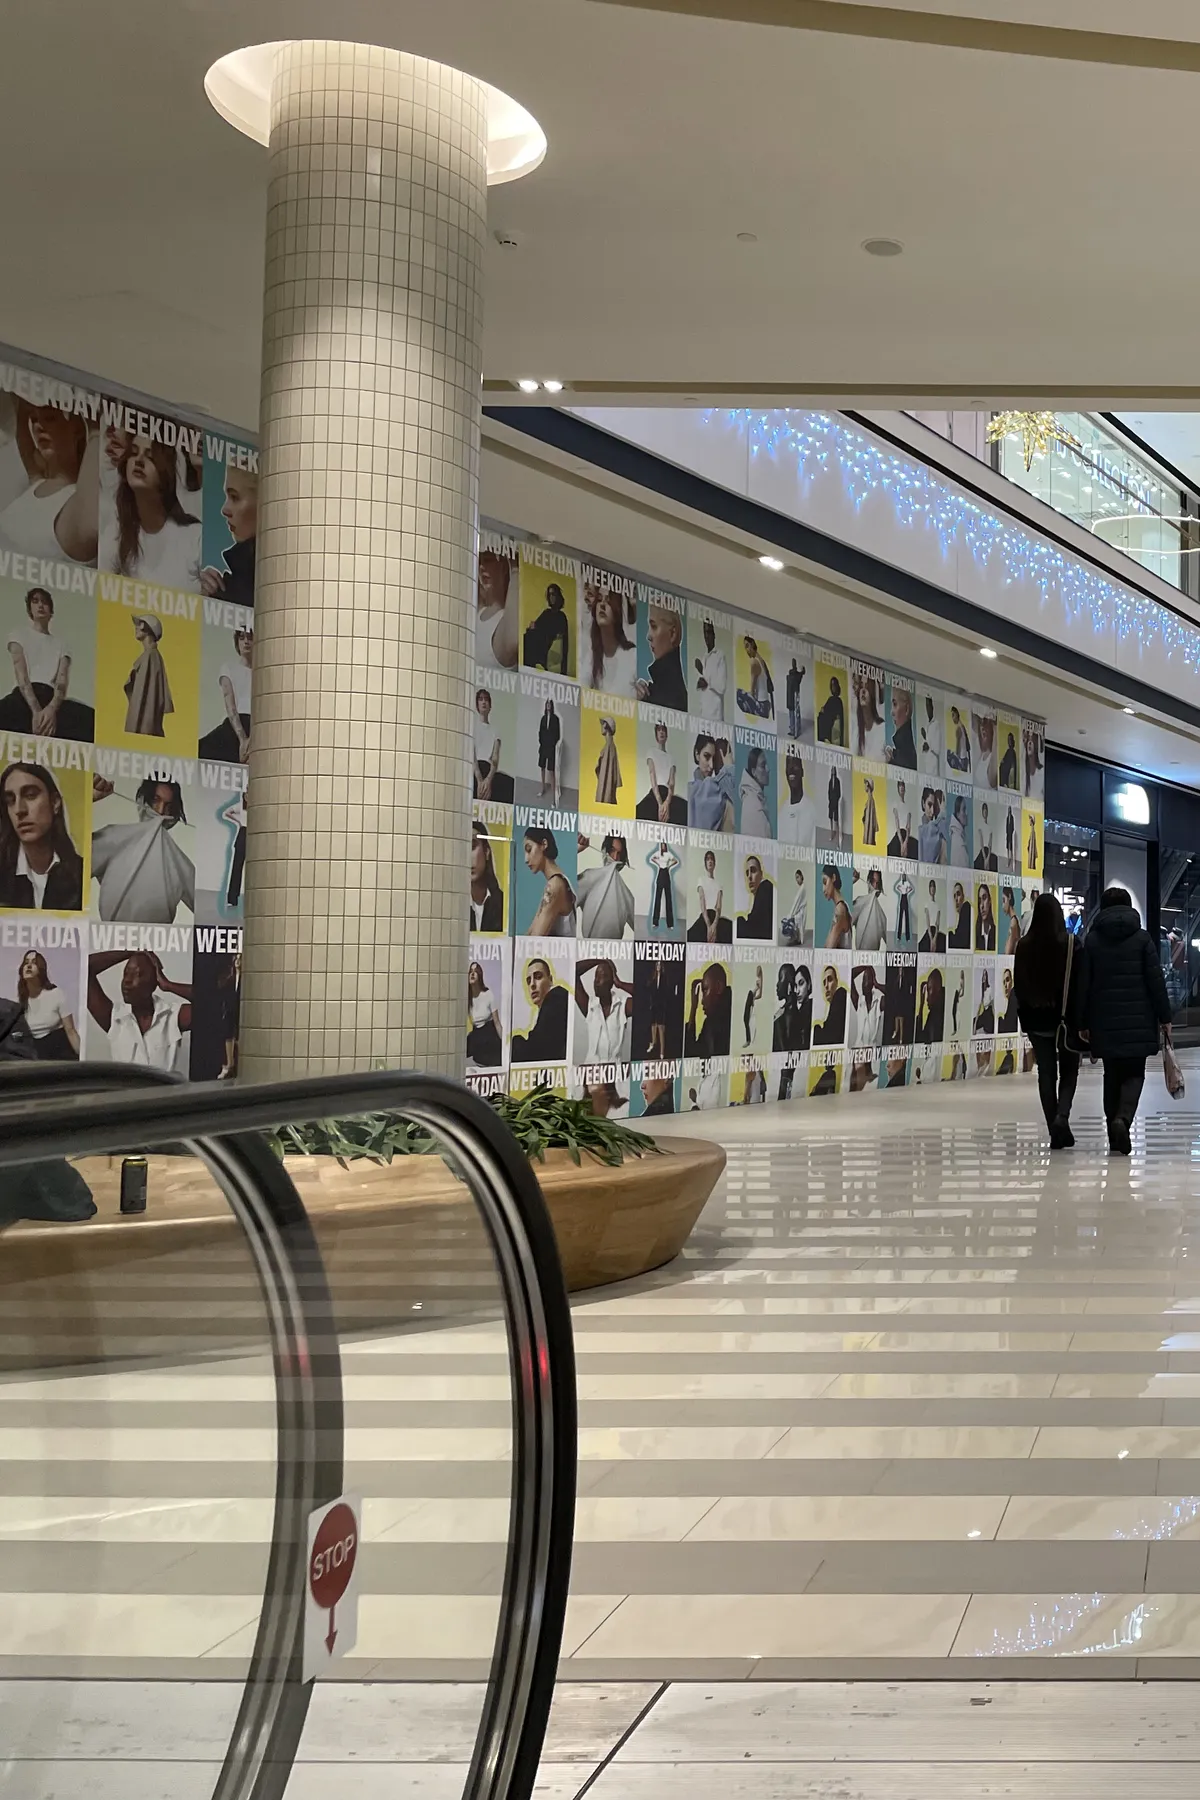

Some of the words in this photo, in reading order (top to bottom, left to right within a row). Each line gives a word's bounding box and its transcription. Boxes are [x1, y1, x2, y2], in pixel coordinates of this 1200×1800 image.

[102, 400, 200, 454] WEEKDAY
[522, 544, 579, 577] WEEKDAY
[582, 564, 636, 599] WEEKDAY
[99, 575, 198, 621] WEEKDAY
[637, 583, 687, 615] WEEKDAY
[851, 660, 884, 684] WEEKDAY
[885, 672, 915, 693] WEEKDAY
[520, 676, 580, 707] WEEKDAY
[582, 688, 636, 720] WEEKDAY
[638, 702, 687, 731] WEEKDAY
[735, 728, 777, 751] WEEKDAY
[96, 749, 195, 786] WEEKDAY
[815, 748, 852, 771] WEEKDAY
[946, 780, 973, 798] WEEKDAY
[516, 806, 577, 833] WEEKDAY
[580, 815, 634, 840] WEEKDAY
[637, 822, 686, 846] WEEKDAY
[689, 832, 733, 852] WEEKDAY
[778, 844, 815, 863] WEEKDAY
[816, 848, 852, 869] WEEKDAY
[854, 856, 887, 872] WEEKDAY
[887, 858, 918, 875] WEEKDAY
[91, 925, 192, 952] WEEKDAY
[578, 941, 633, 960] WEEKDAY
[635, 942, 685, 961] WEEKDAY
[688, 946, 732, 963] WEEKDAY
[735, 946, 776, 964] WEEKDAY
[777, 948, 813, 965] WEEKDAY
[853, 952, 886, 966] WEEKDAY
[886, 952, 917, 967] WEEKDAY
[848, 1047, 881, 1063] WEEKDAY
[882, 1044, 913, 1061] WEEKDAY
[574, 1064, 629, 1085] WEEKDAY
[632, 1060, 681, 1081] WEEKDAY
[684, 1057, 728, 1077] WEEKDAY
[313, 1534, 354, 1580] STOP
